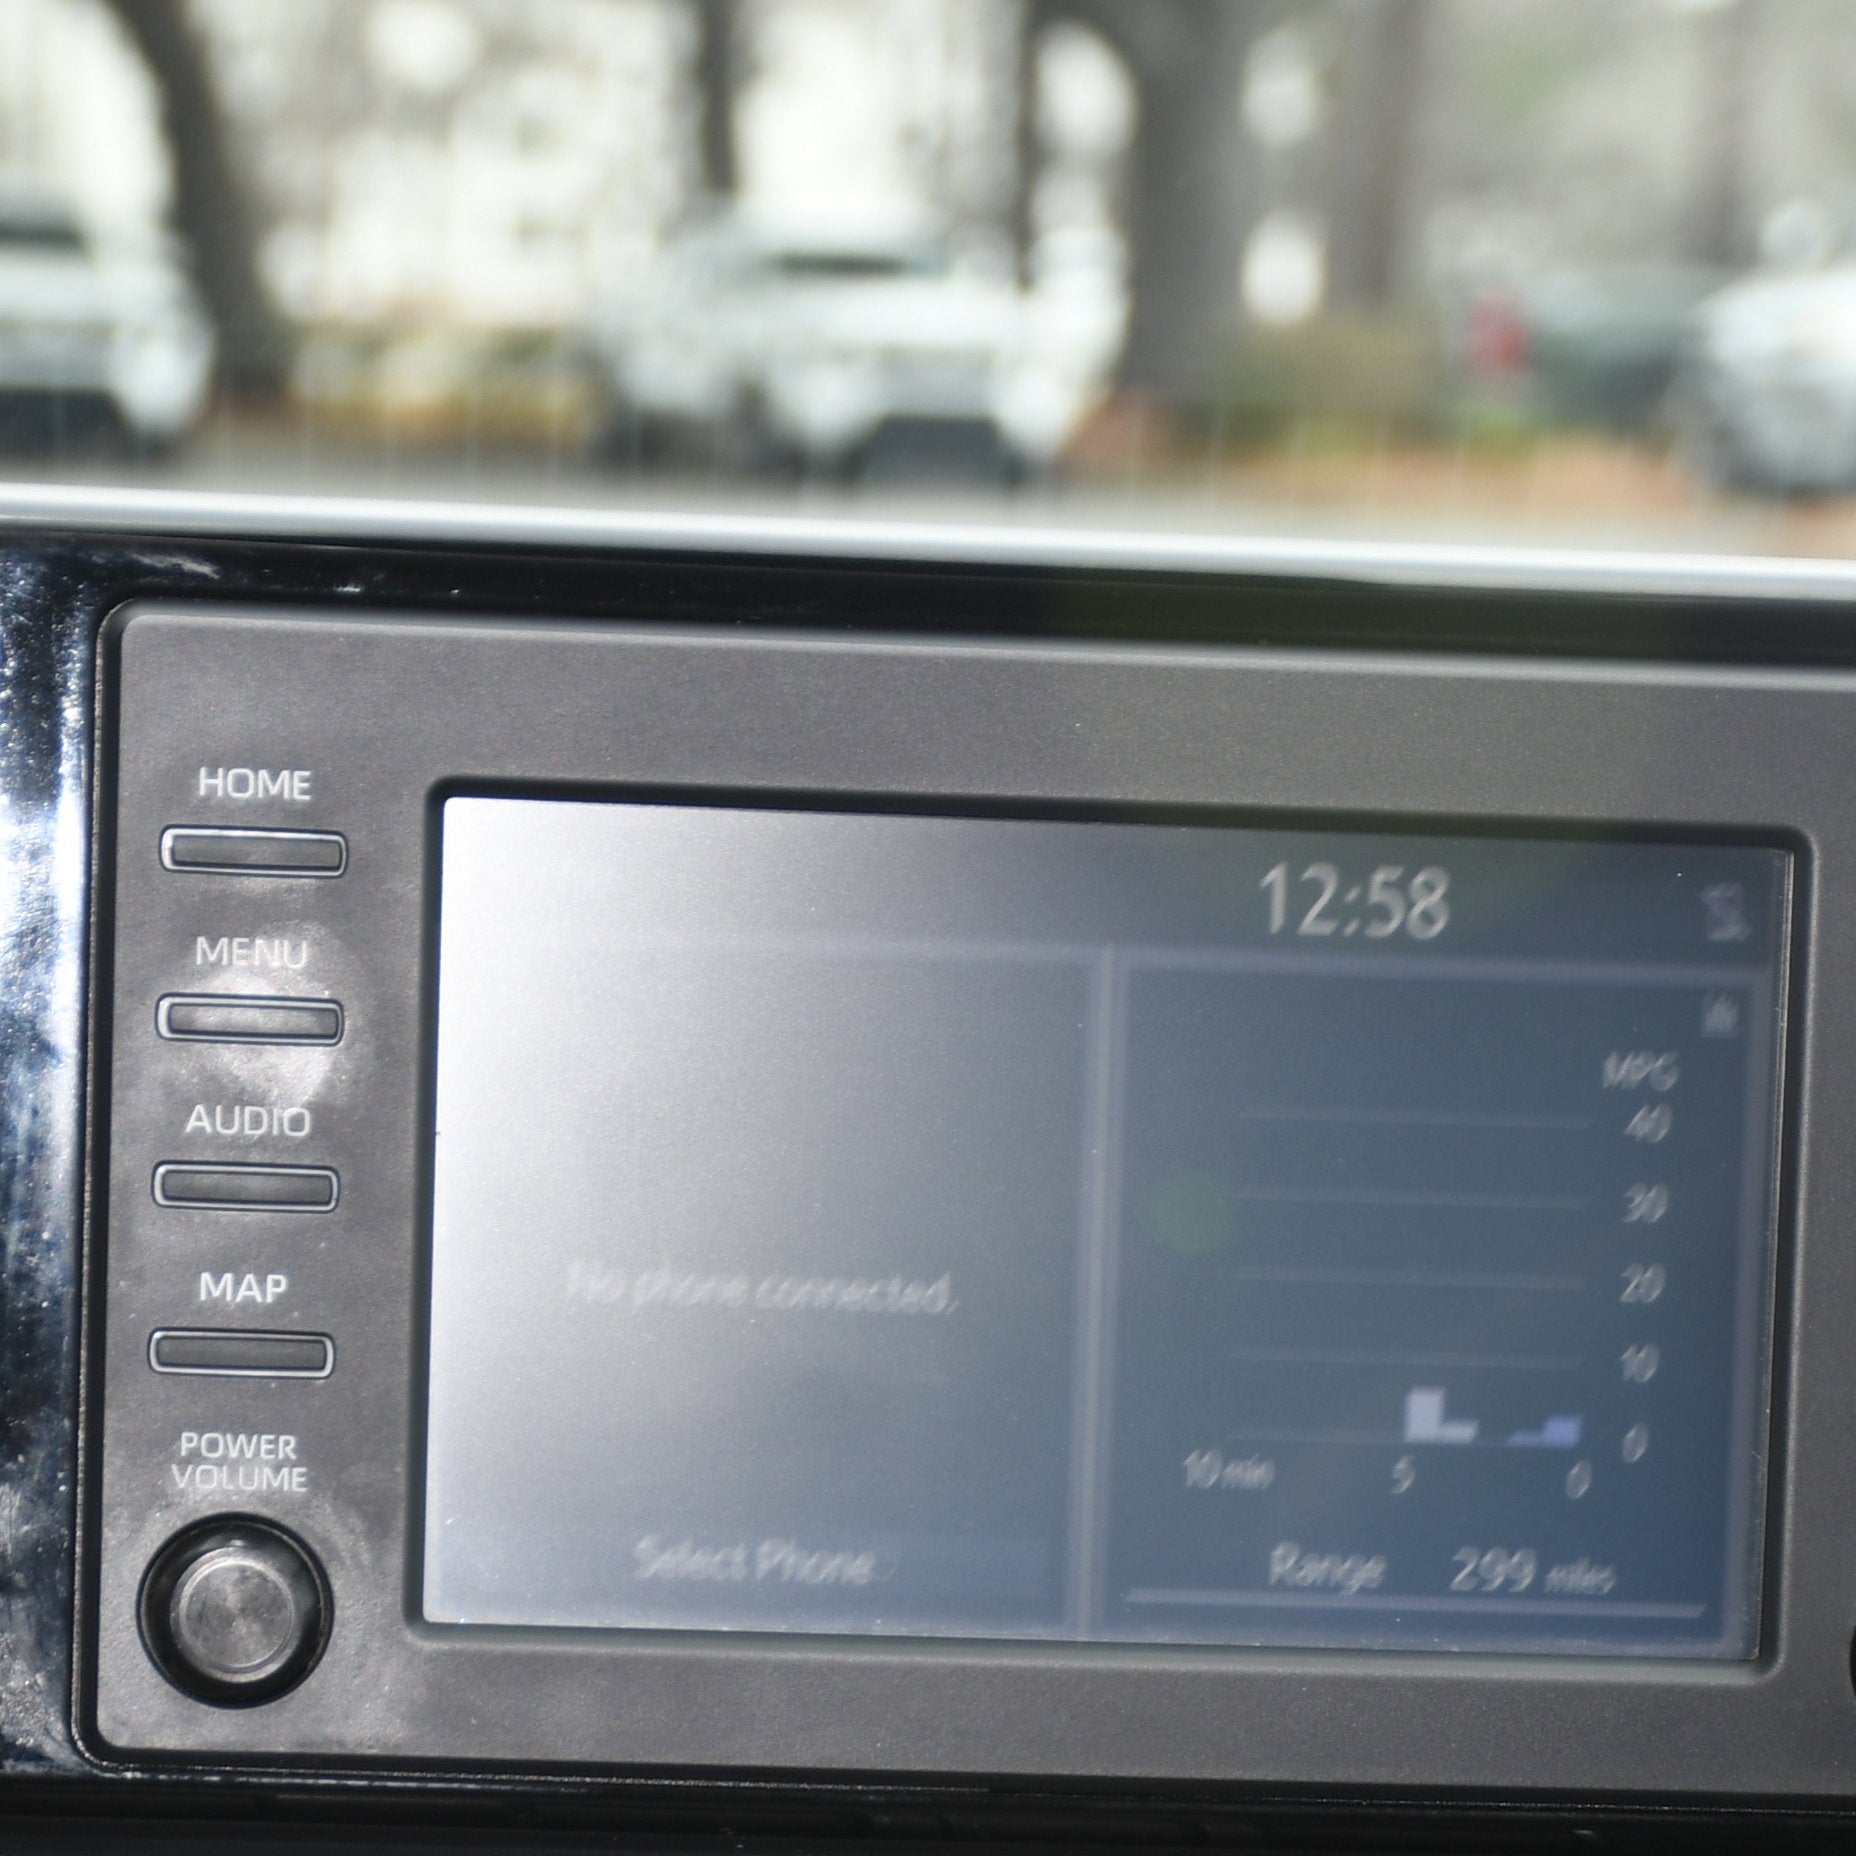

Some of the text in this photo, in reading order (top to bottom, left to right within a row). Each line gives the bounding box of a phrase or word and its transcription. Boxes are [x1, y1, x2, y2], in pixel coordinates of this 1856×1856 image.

[198, 767, 313, 802] HOME
[1259, 861, 1453, 941] 12:58
[194, 935, 310, 969] MENU
[1601, 1050, 1681, 1093] MPG
[184, 1104, 313, 1138] AUDIO
[1624, 1102, 1675, 1143] 40
[1622, 1182, 1670, 1224] 30
[197, 1273, 289, 1304] MAP
[1619, 1262, 1667, 1303] 20
[1619, 1343, 1661, 1385] 10
[178, 1431, 298, 1461] POWER
[1622, 1423, 1650, 1463] 0
[171, 1463, 309, 1493] VOLUME
[1390, 1455, 1416, 1494] 5
[1565, 1459, 1593, 1500] 0
[755, 1537, 878, 1587] Phone
[1269, 1541, 1387, 1595] Range
[1450, 1545, 1538, 1593] 299
